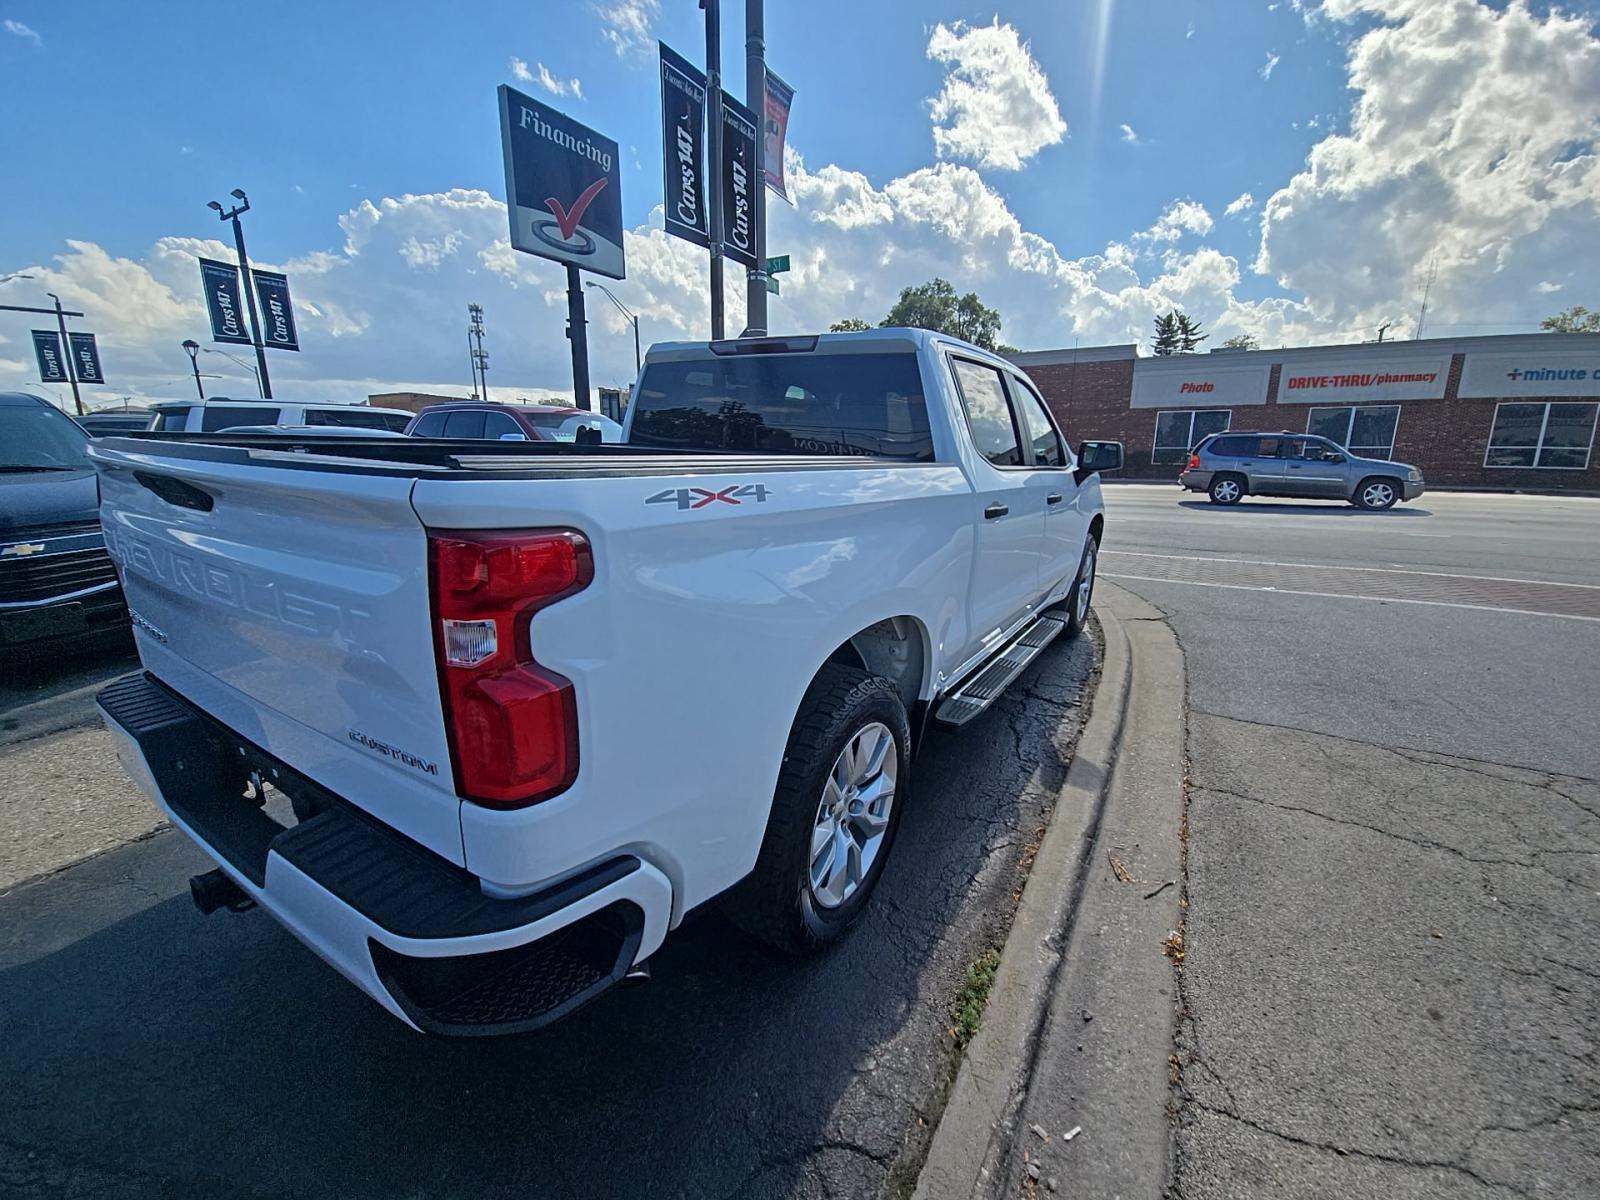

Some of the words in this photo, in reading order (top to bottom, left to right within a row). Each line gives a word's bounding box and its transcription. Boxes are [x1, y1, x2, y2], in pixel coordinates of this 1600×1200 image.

[519, 106, 612, 173] Financing
[677, 125, 697, 225] Cars147
[1180, 382, 1214, 394] Photo
[347, 730, 439, 776] CUSTOM
